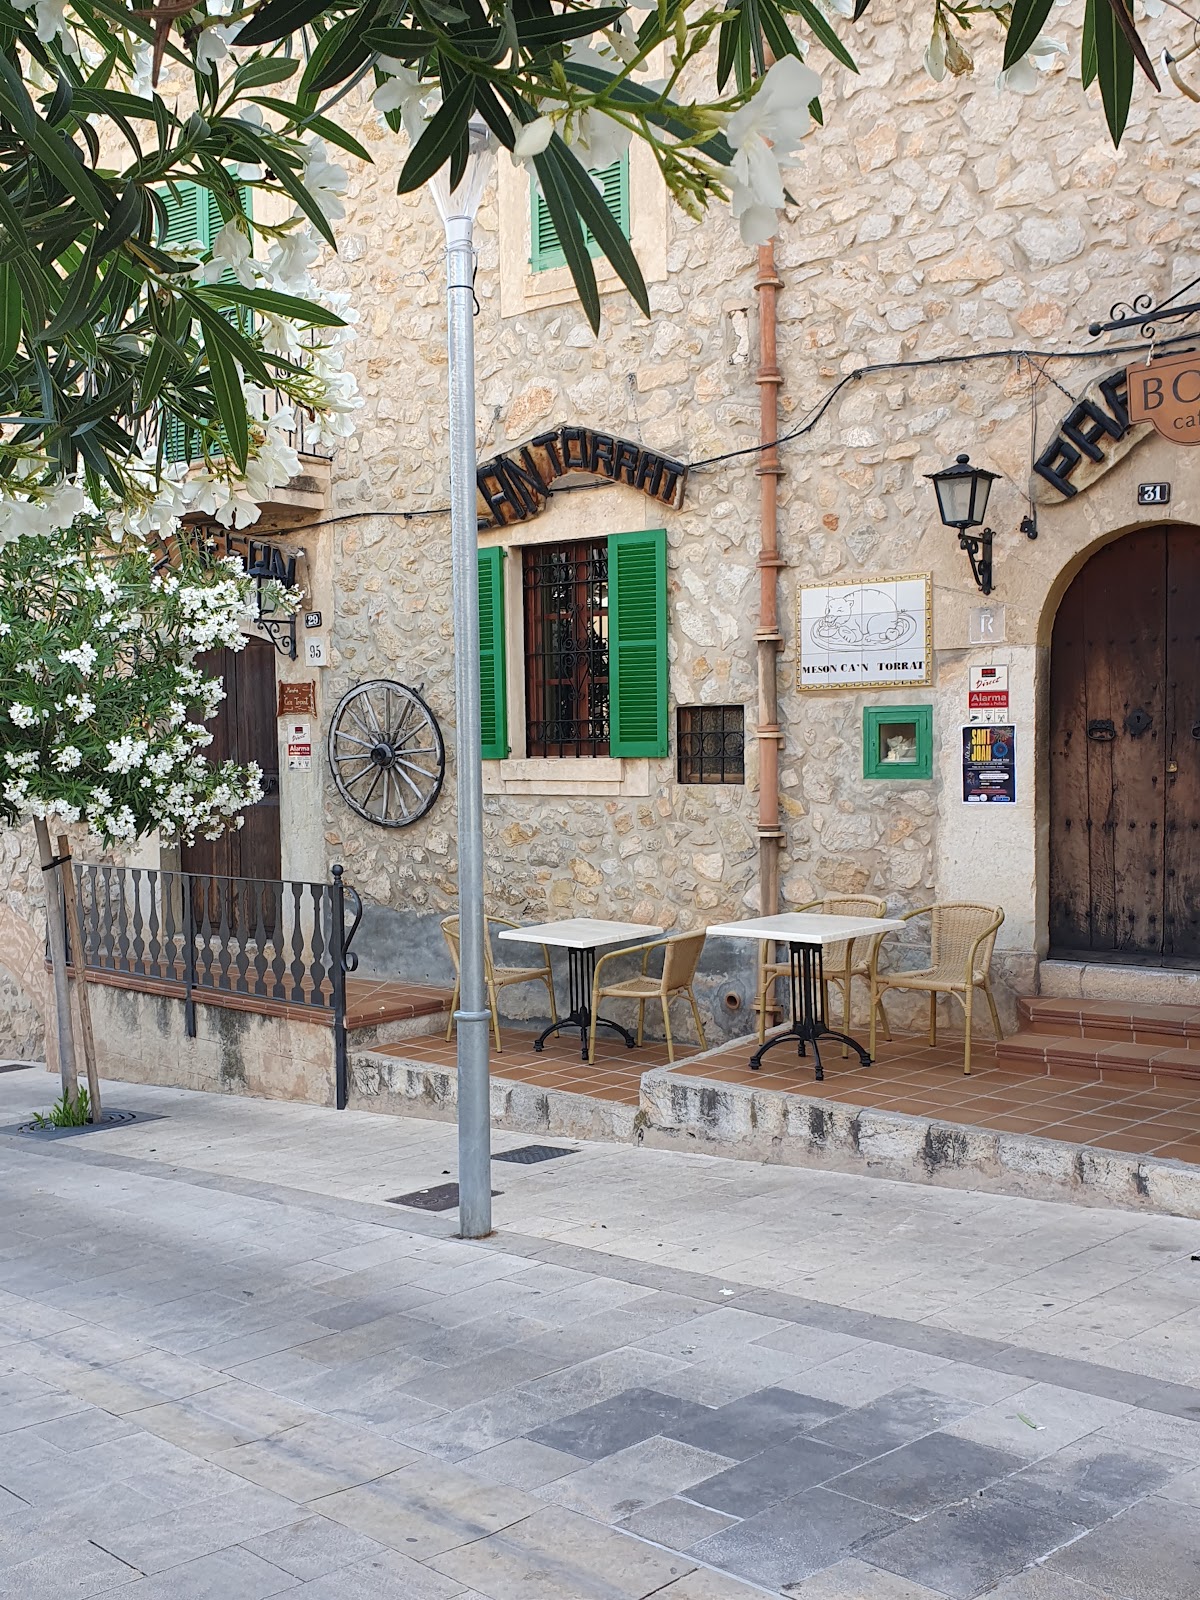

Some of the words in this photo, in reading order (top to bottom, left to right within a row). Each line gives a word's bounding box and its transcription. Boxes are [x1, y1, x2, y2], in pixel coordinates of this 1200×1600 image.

[531, 427, 686, 502] TORRAT
[1143, 486, 1161, 501] 31
[307, 614, 318, 625] 29
[309, 644, 321, 658] 95
[802, 664, 837, 674] MESON
[877, 660, 924, 671] TORRAT
[971, 693, 1006, 702] Alarma
[971, 728, 991, 745] SANT
[971, 745, 992, 761] JOAN
